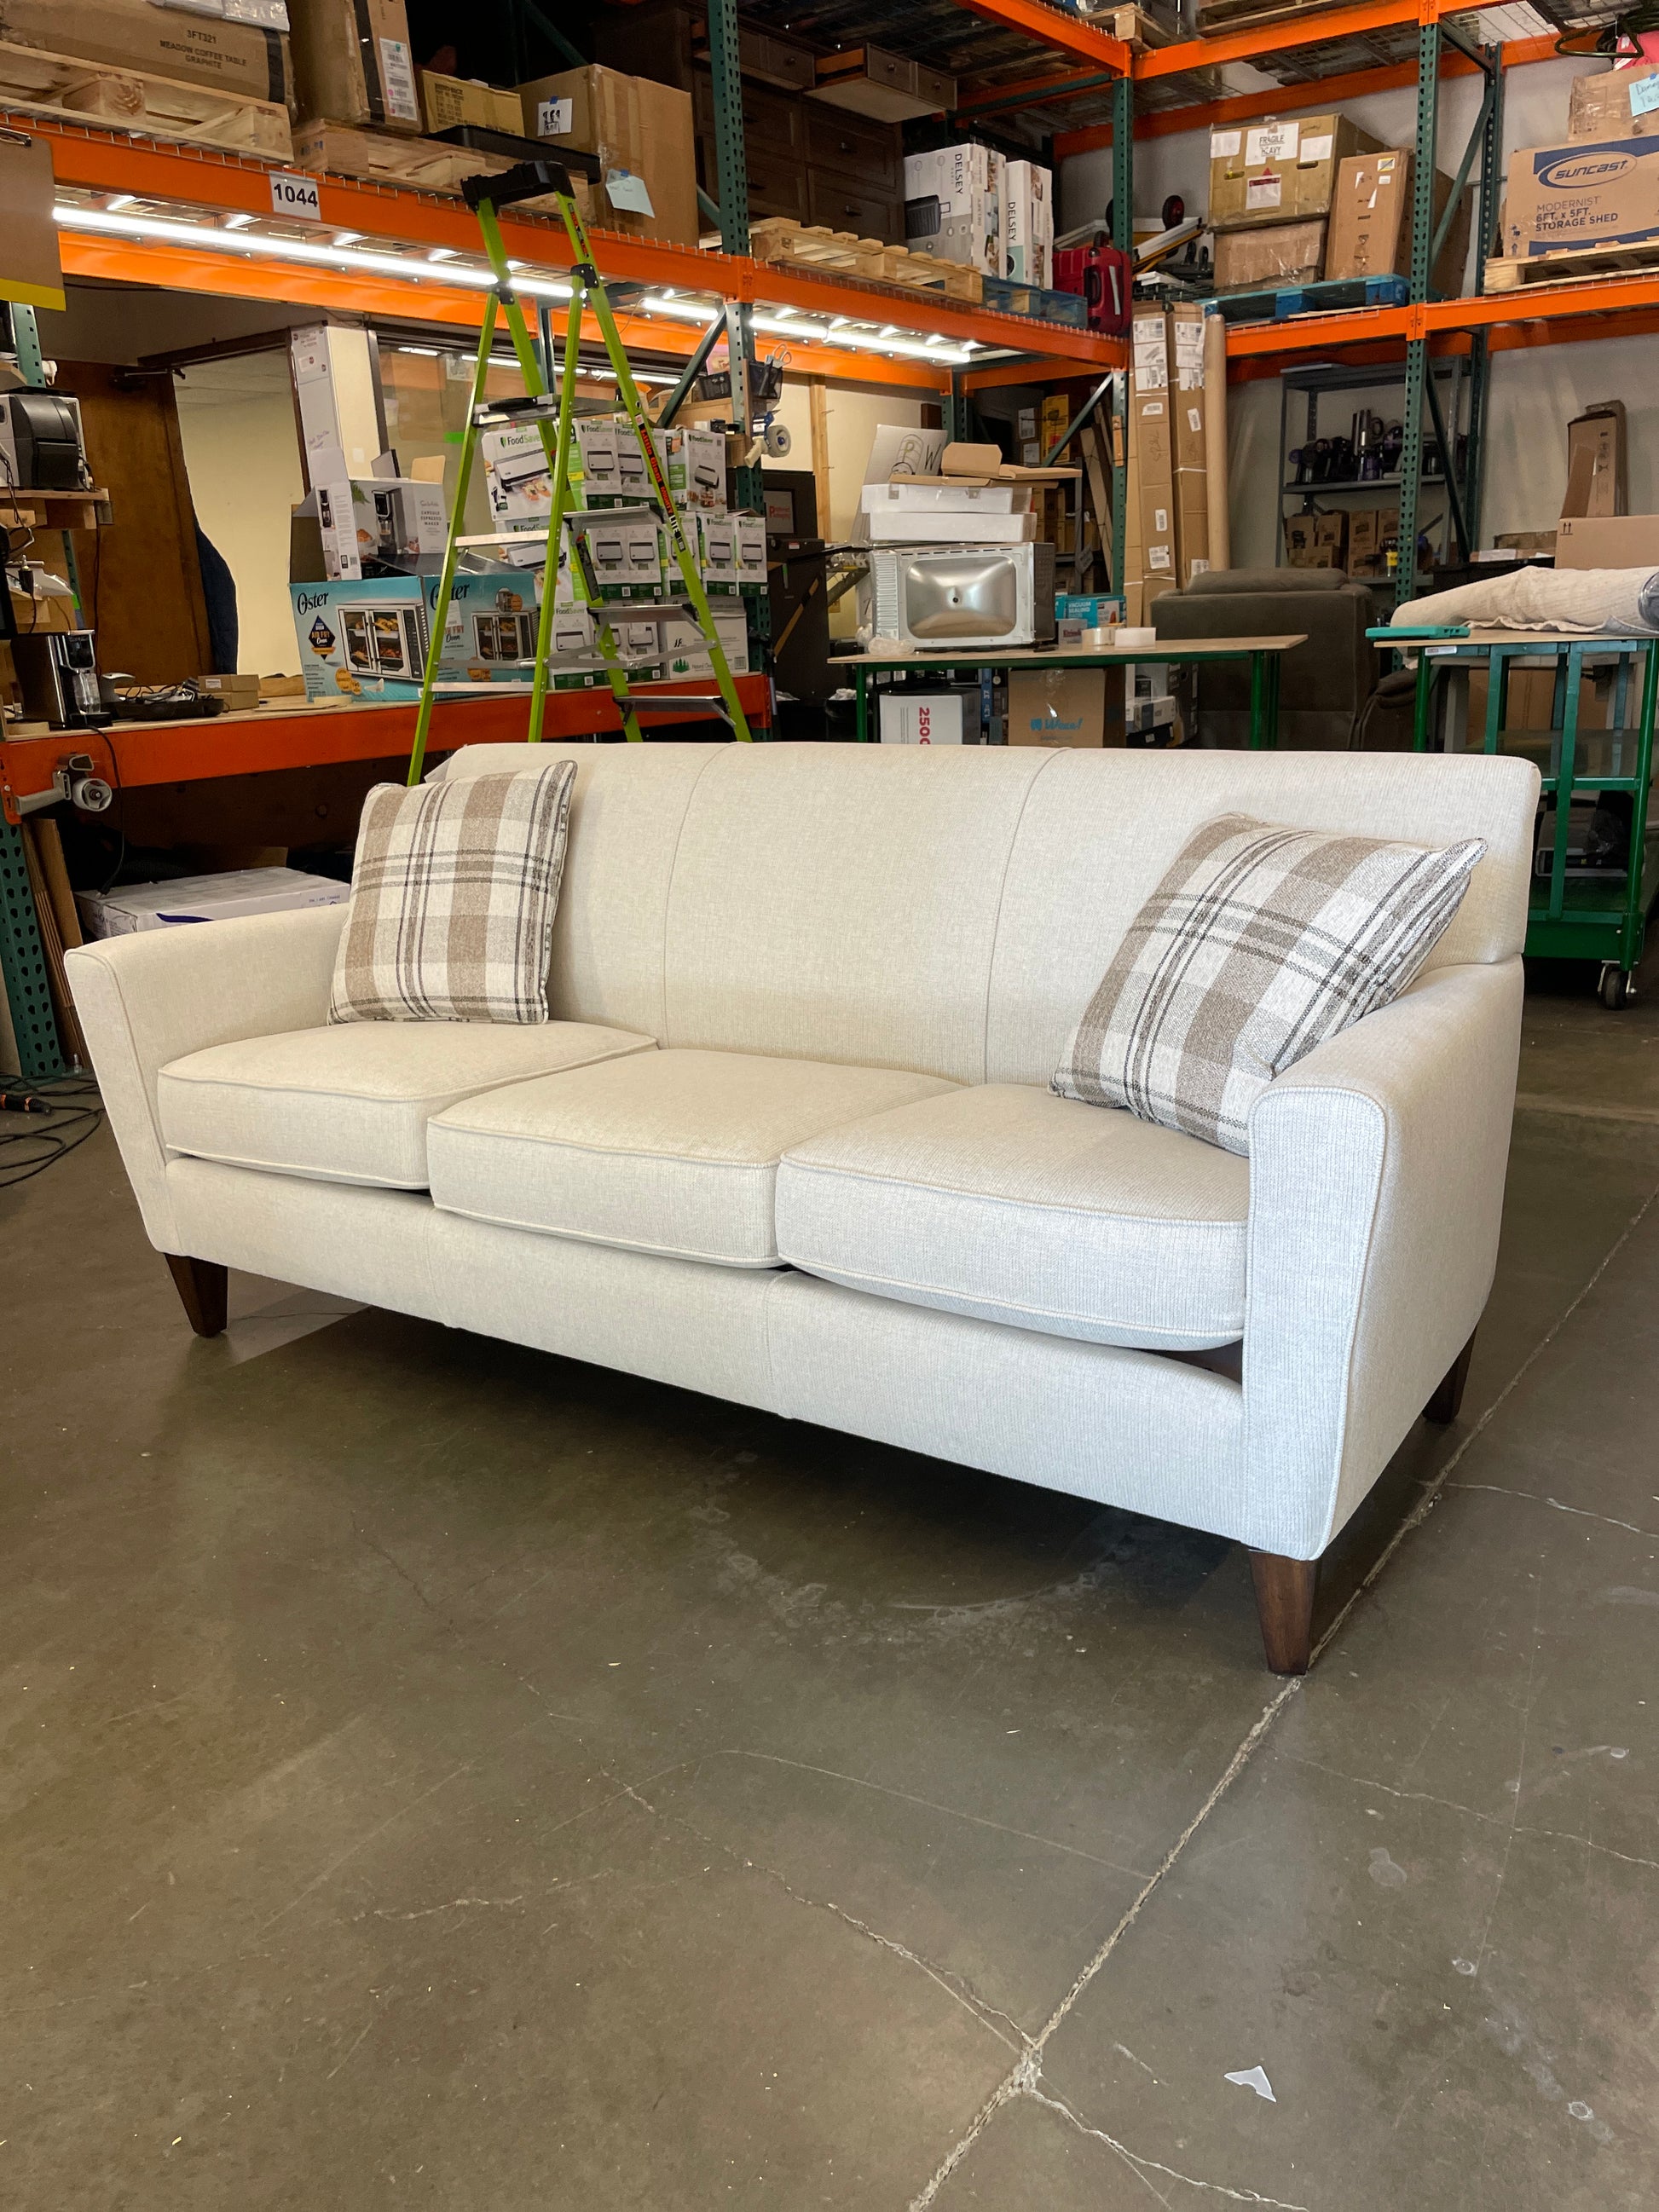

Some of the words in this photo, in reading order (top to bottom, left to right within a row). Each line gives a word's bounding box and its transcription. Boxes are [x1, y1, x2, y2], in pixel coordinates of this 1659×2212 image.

[187, 29, 217, 43] 3FT321
[159, 39, 194, 54] MEADOW
[194, 48, 223, 61] COFFEE
[224, 55, 247, 66] TABLE
[185, 55, 223, 69] GRAPHITE
[1259, 135, 1285, 144] FRAGILE
[954, 153, 964, 195] DELSEY
[274, 183, 318, 207] 1044
[1536, 197, 1598, 212] MODERNIST
[1008, 201, 1017, 241] DELSEY
[1535, 216, 1586, 232] STORAGE
[1589, 212, 1618, 225] SHED
[1536, 211, 1558, 222] 6FT.
[1569, 207, 1591, 218] 5FT.
[507, 435, 540, 445] FoodSave
[640, 429, 653, 455] Little
[650, 456, 662, 483] Giant
[298, 592, 329, 615] Oster
